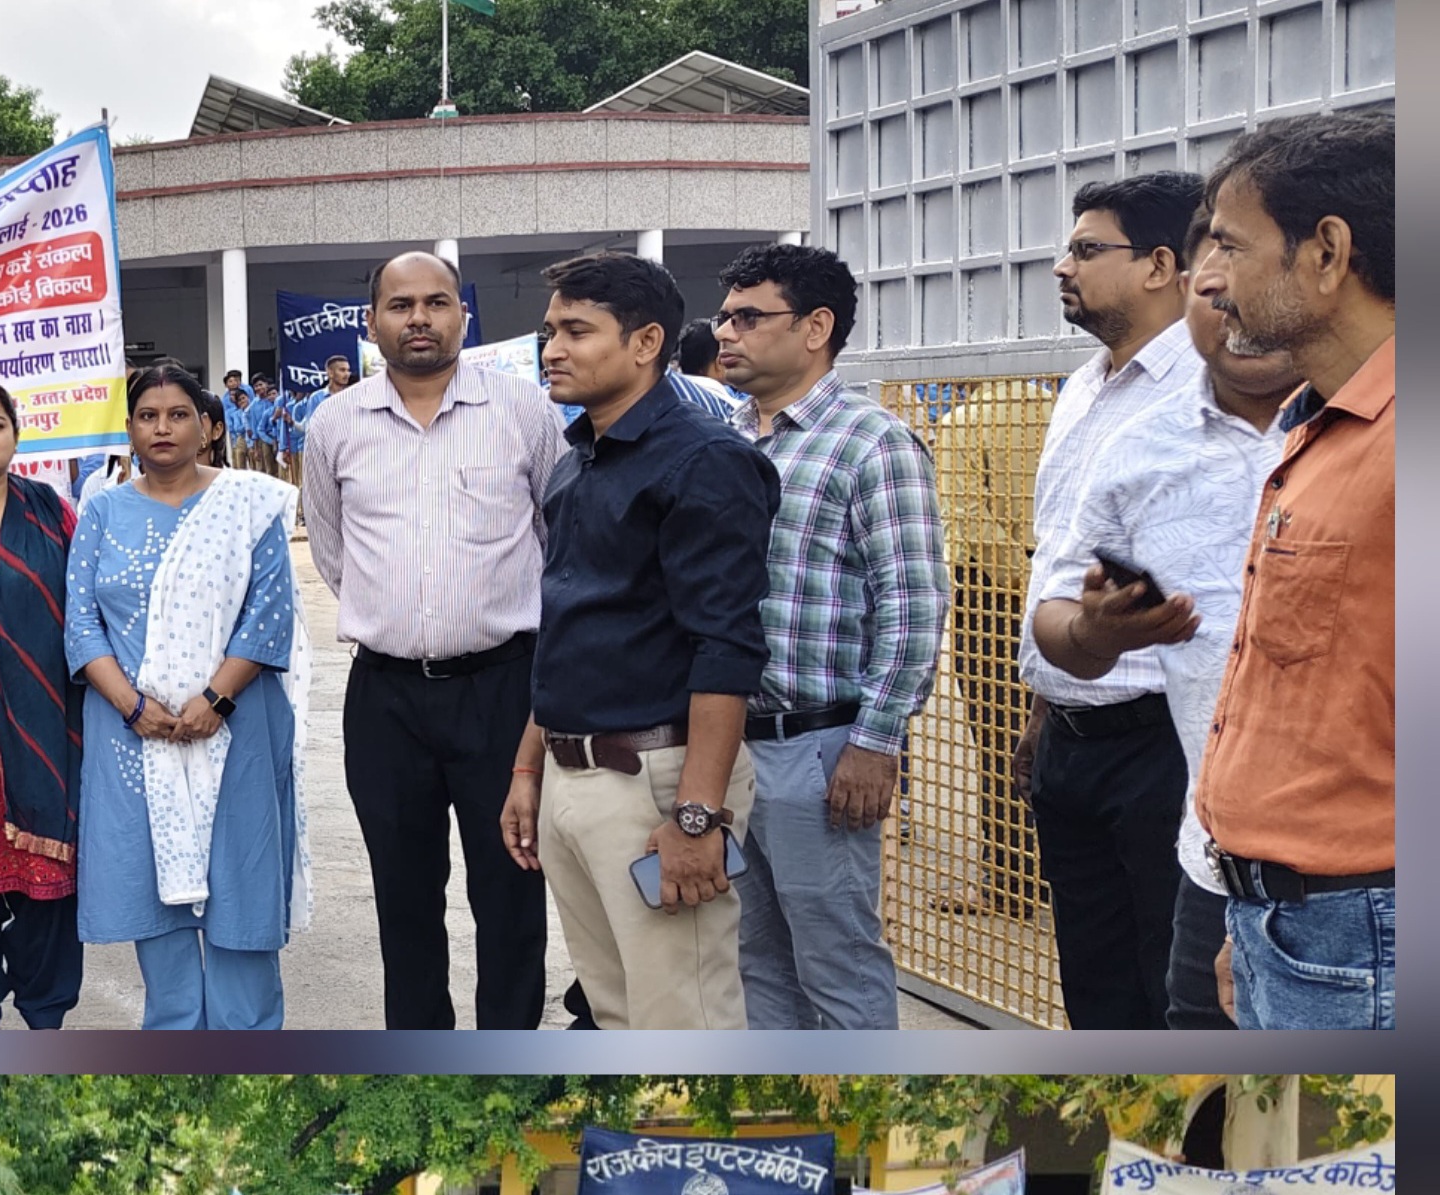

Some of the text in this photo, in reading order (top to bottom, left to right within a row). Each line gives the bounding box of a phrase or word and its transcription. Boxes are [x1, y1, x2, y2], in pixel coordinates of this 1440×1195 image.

[41, 204, 89, 231] 2026
[6, 250, 32, 276] करें
[35, 245, 92, 269] संकल्प
[35, 275, 93, 299] विकल्प
[12, 320, 35, 343] सब
[39, 317, 59, 338] का
[63, 313, 93, 335] नारा
[284, 303, 359, 343] राजकीय
[71, 384, 108, 403] प्रदेश
[586, 1138, 684, 1183] राजकीय
[684, 1143, 758, 1175] इण्टर
[754, 1145, 828, 1194] कॉलेज
